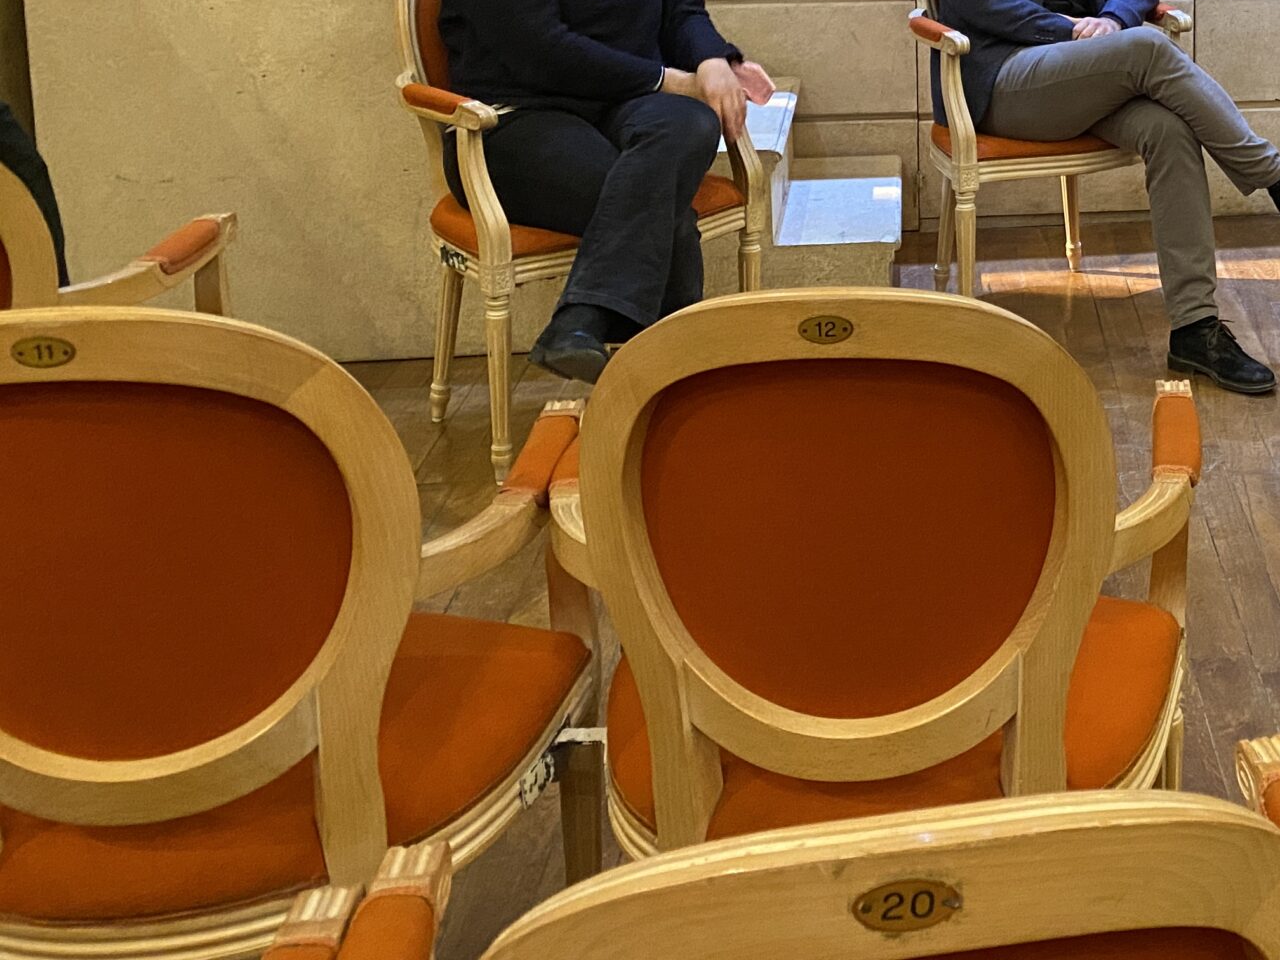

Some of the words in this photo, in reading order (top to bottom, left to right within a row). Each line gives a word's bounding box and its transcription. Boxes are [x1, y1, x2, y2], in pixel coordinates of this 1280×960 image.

[815, 321, 837, 338] 12
[33, 344, 54, 360] 11
[881, 890, 935, 921] 20
